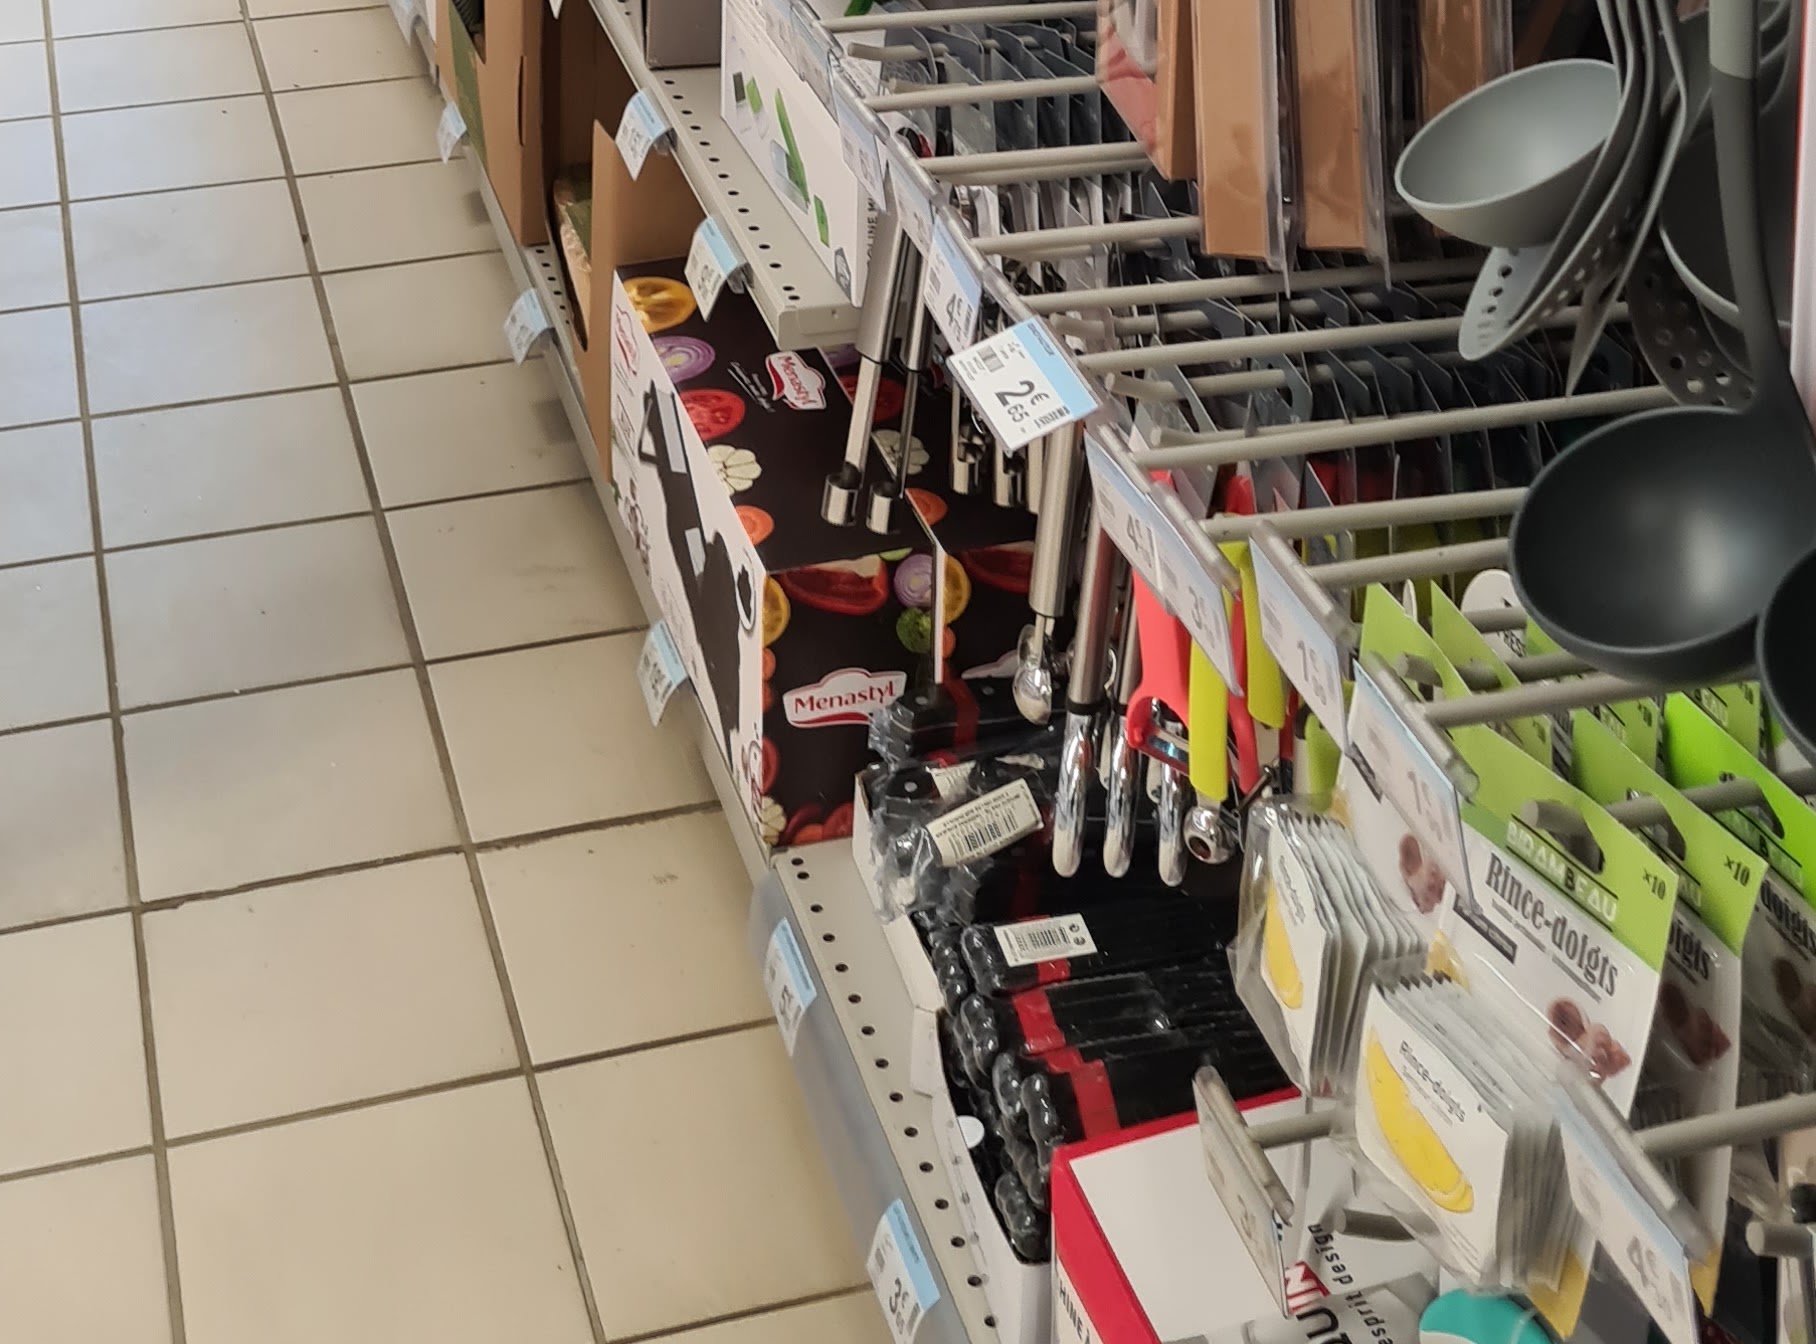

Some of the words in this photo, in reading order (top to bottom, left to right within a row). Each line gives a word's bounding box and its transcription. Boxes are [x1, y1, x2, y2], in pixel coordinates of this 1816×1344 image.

[794, 680, 895, 715] Menastyl
[1485, 852, 1619, 997] Rince-doigts
[1309, 1224, 1354, 1286] design
